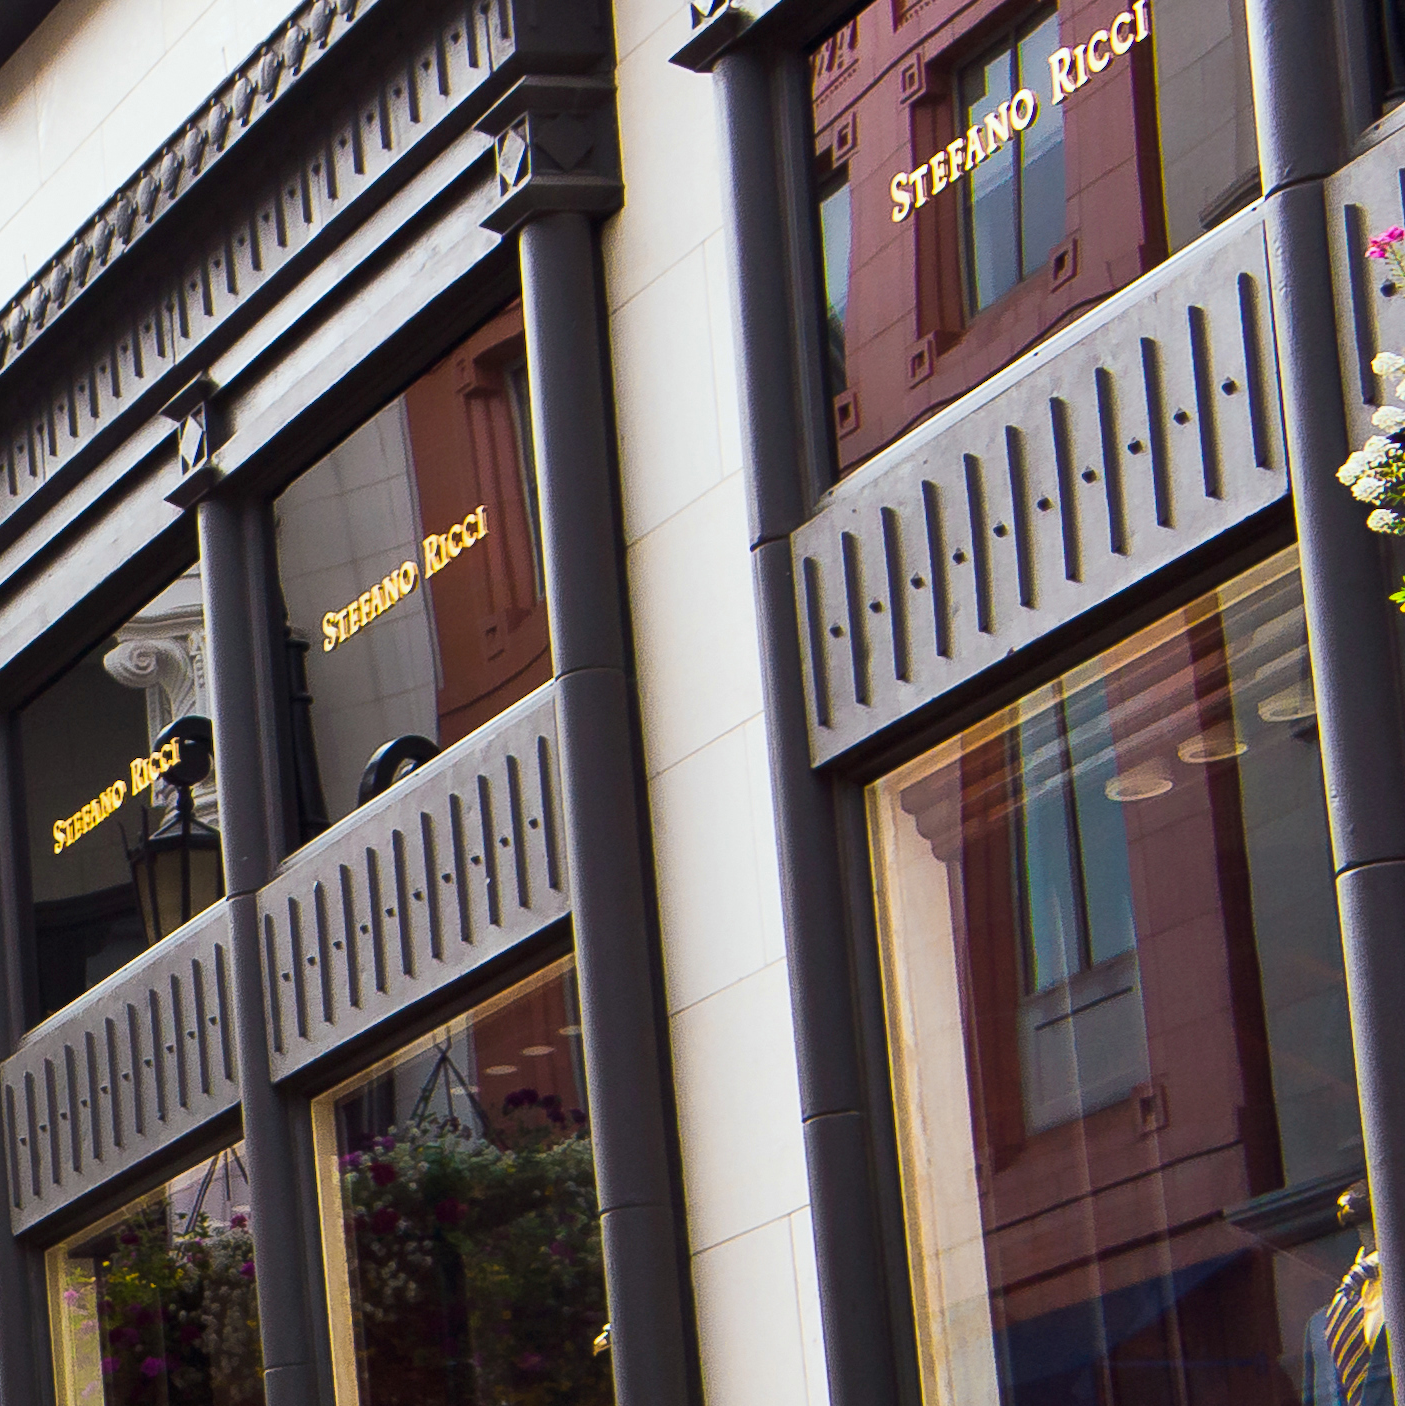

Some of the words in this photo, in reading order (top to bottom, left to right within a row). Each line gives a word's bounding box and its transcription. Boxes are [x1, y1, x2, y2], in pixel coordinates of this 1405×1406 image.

[890, 88, 1039, 223] STEFANO
[1048, 0, 1151, 105] RICCI
[322, 561, 419, 652] STEFANO
[423, 505, 489, 580] RICCI
[53, 780, 127, 855] STEFANO
[130, 737, 181, 796] RICCI
